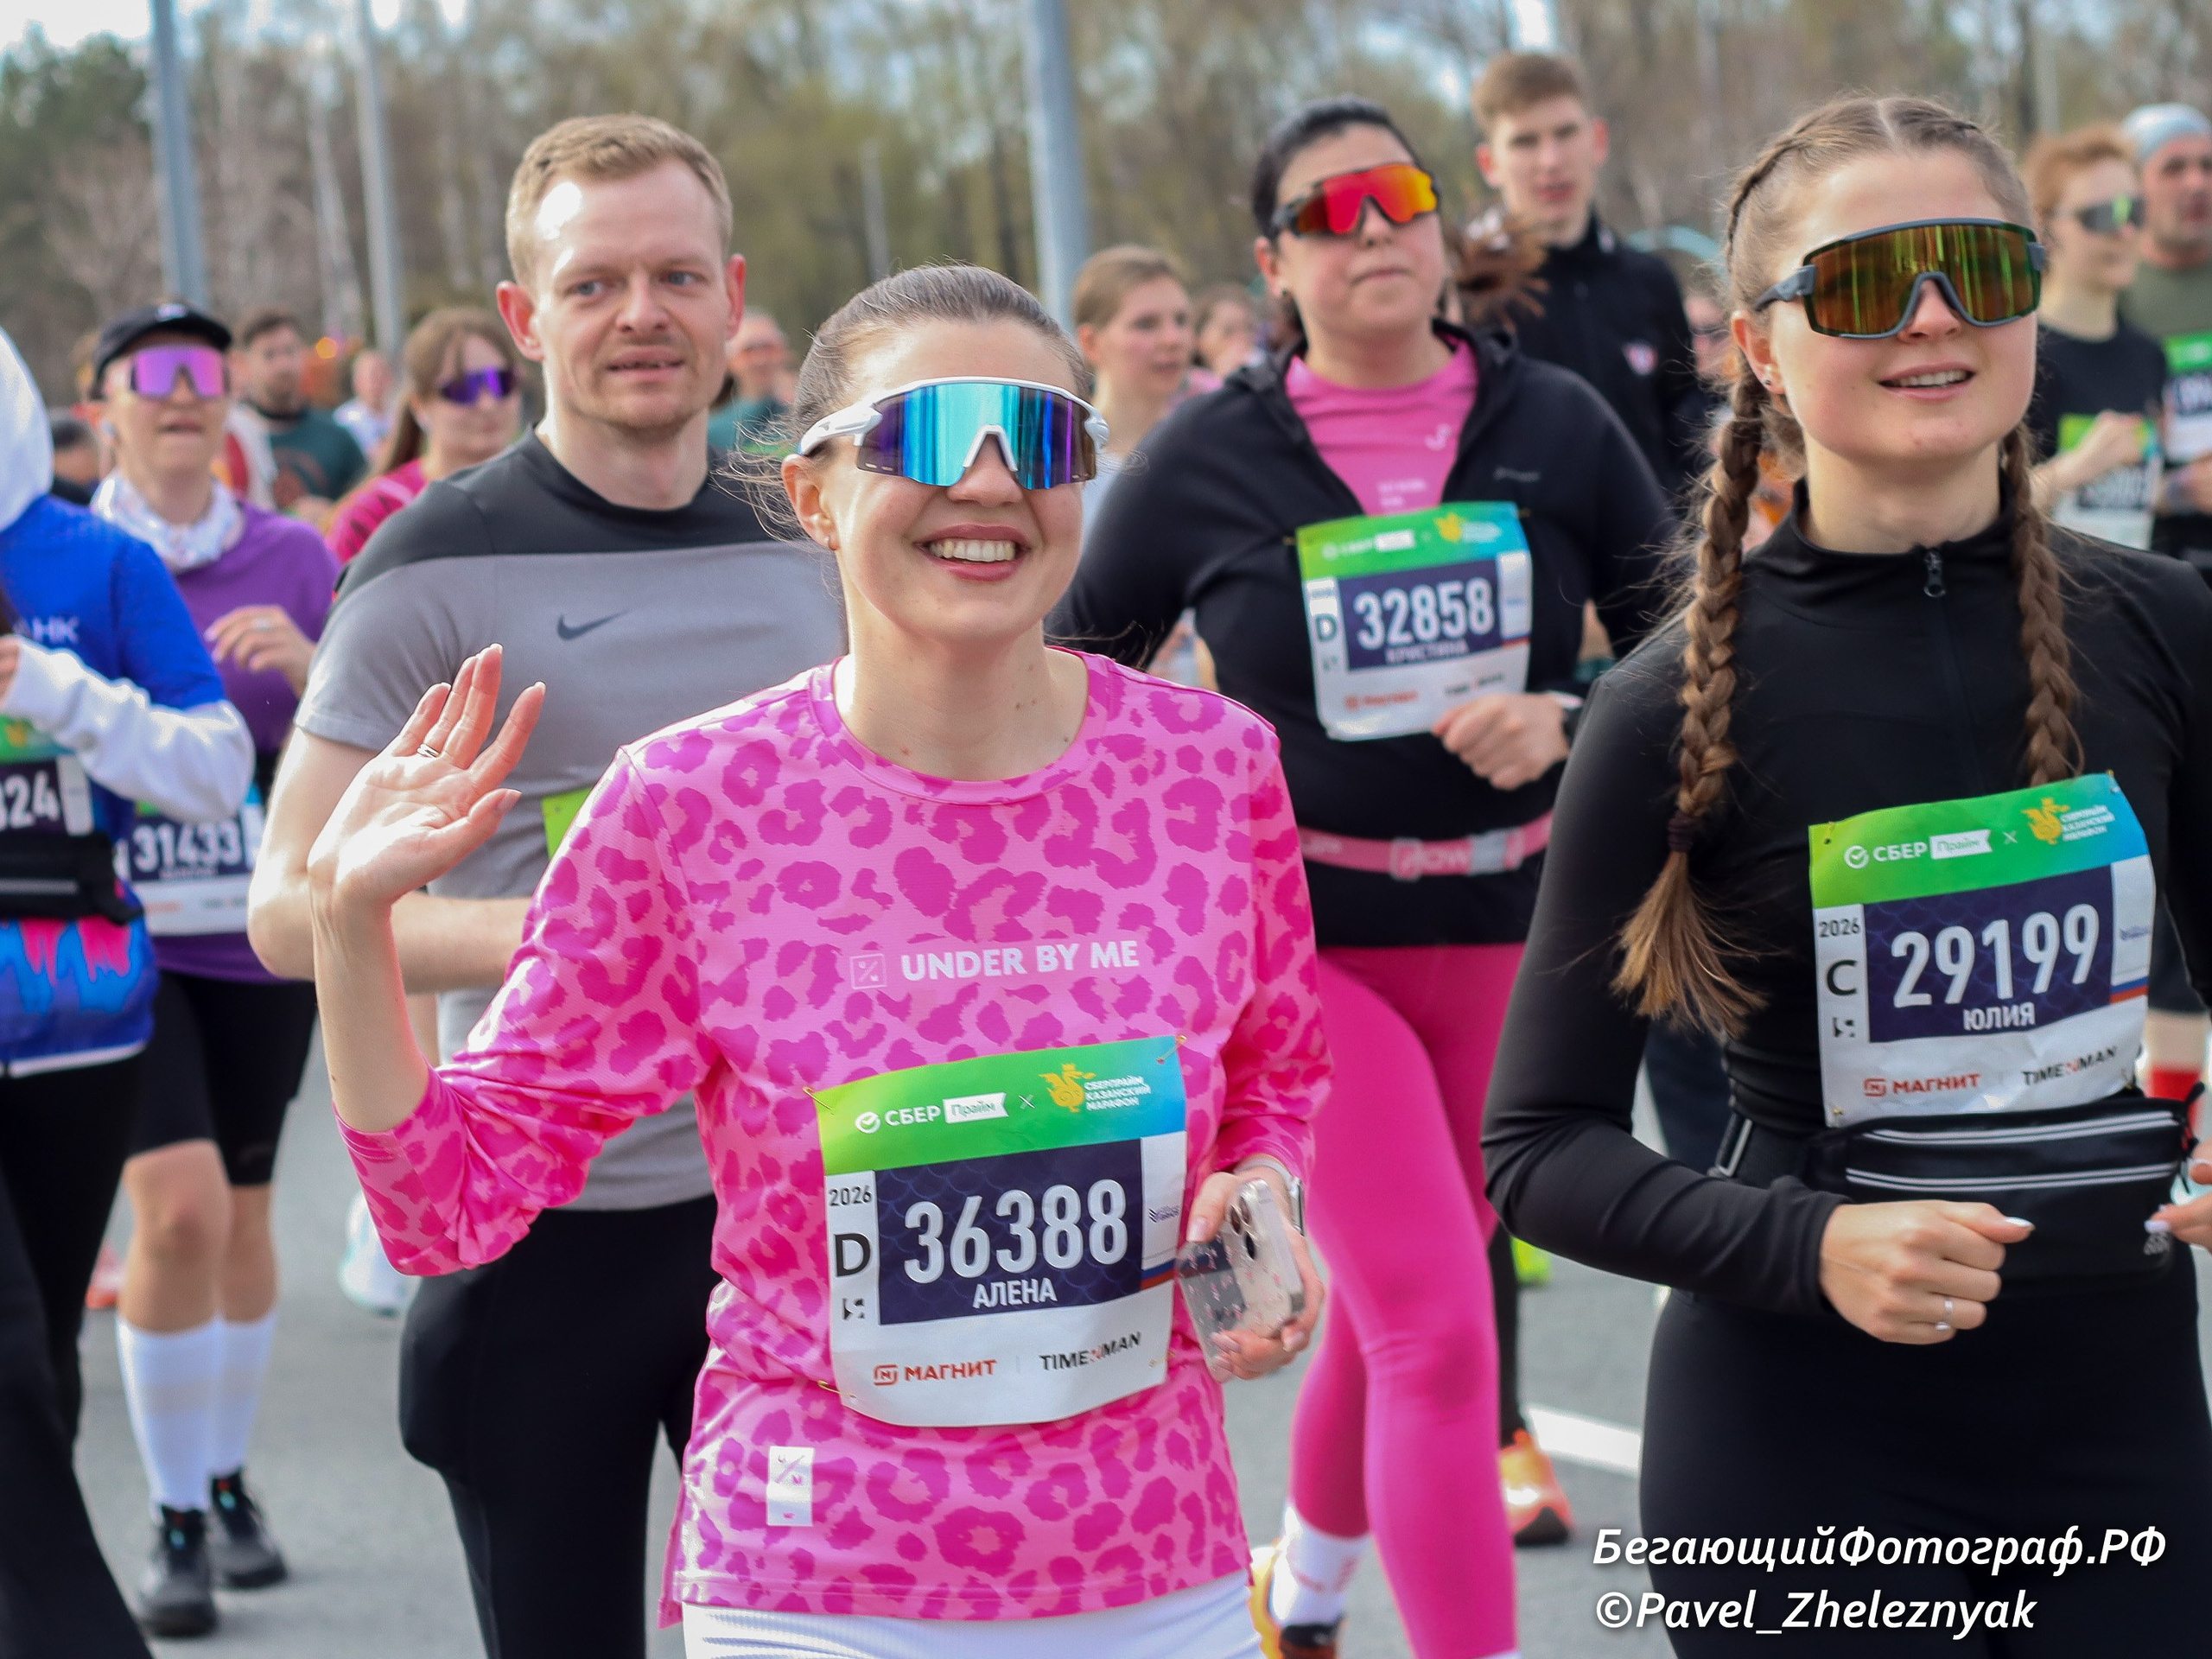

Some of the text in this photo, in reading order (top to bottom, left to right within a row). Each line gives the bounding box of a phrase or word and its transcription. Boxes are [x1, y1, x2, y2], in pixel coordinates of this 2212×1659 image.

[1315, 613, 1338, 641] D
[1352, 576, 1495, 651] 32858
[0, 771, 60, 830] 24
[133, 818, 243, 873] 31433
[1872, 842, 1928, 862] СБЕР
[1819, 918, 1860, 938] 2026
[901, 940, 1141, 982] UNDER BY ME
[1891, 903, 2100, 1008] 29199
[1826, 959, 1859, 996] C
[1962, 1001, 2036, 1031] ЮЛИЯ
[1893, 1073, 1982, 1095] МАГНИТ
[885, 1099, 996, 1127] СБЕР Прайм
[829, 1185, 873, 1206] 2026
[904, 1179, 1128, 1284] 36388
[835, 1233, 872, 1277] D
[972, 1277, 1058, 1310] АЛЕНА
[904, 1358, 998, 1382] МАГНИТ
